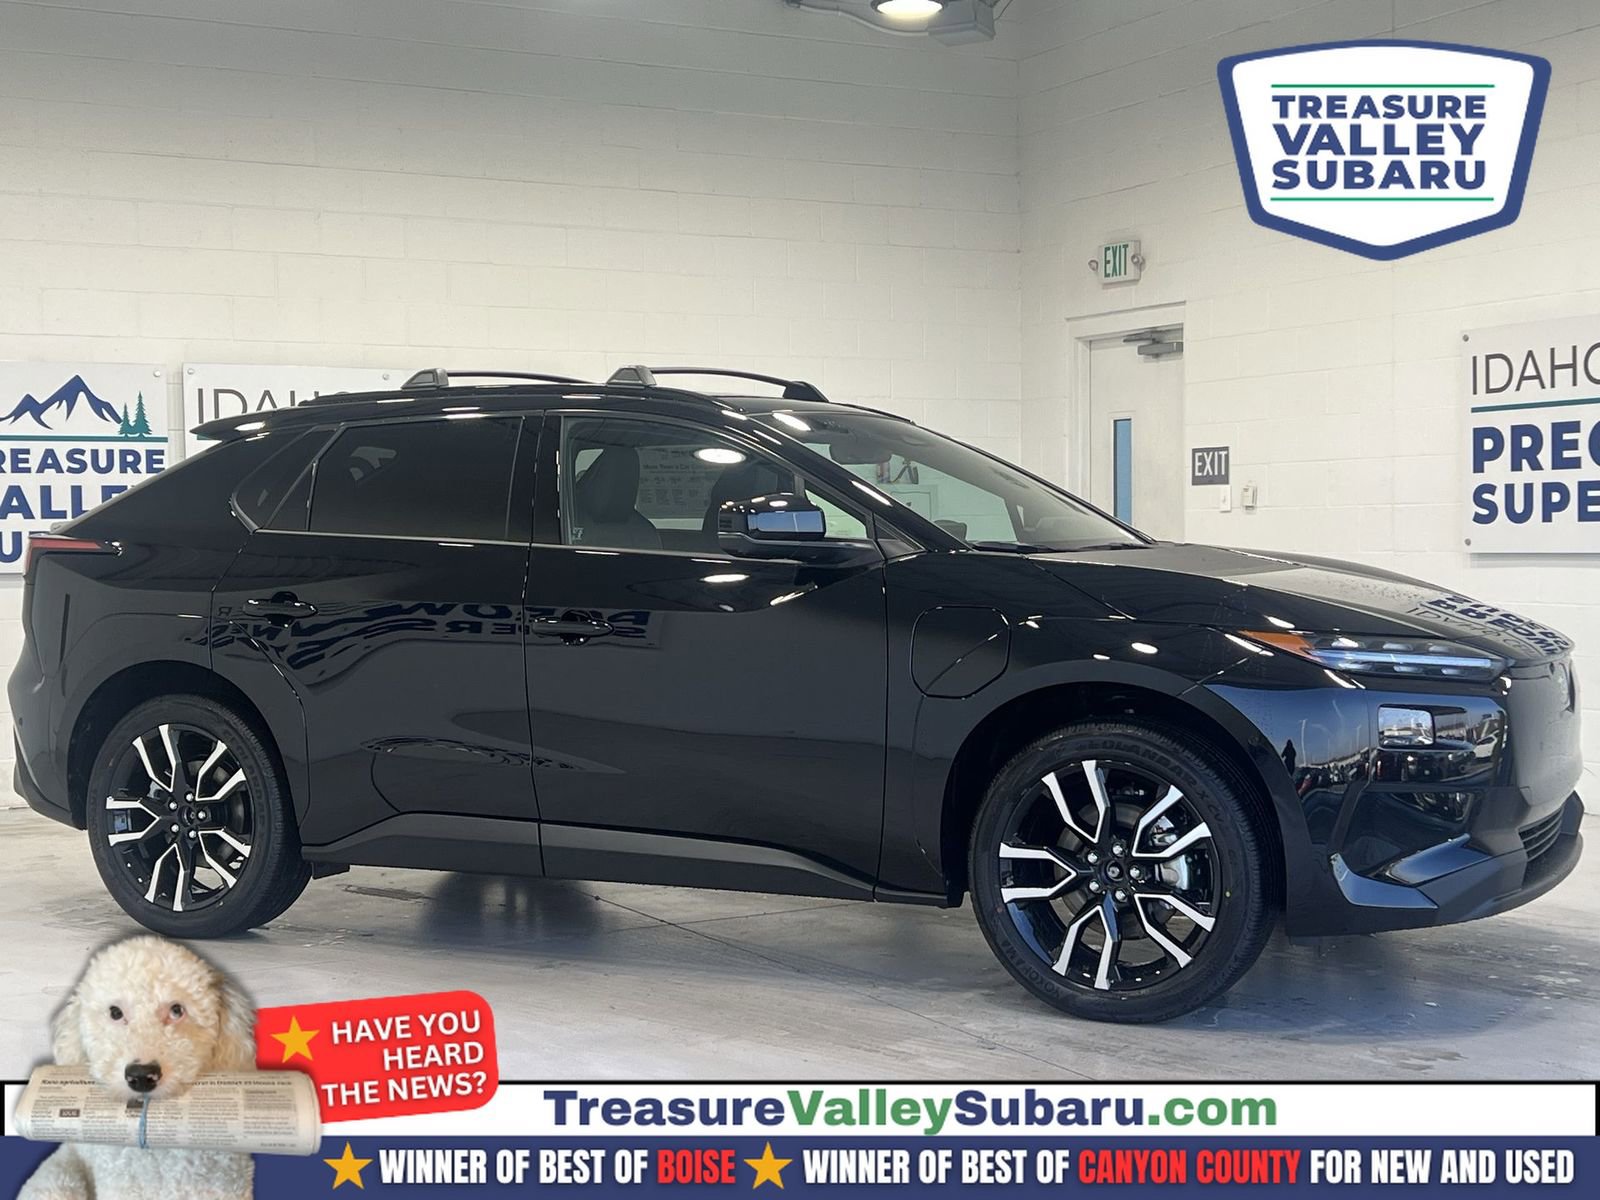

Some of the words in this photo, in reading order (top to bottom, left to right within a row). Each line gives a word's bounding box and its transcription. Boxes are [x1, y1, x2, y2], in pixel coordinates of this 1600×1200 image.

[1104, 244, 1129, 278] EXIT
[0, 447, 165, 475] EASURE
[1195, 450, 1227, 477] EXIT
[1472, 480, 1600, 525] SUPE
